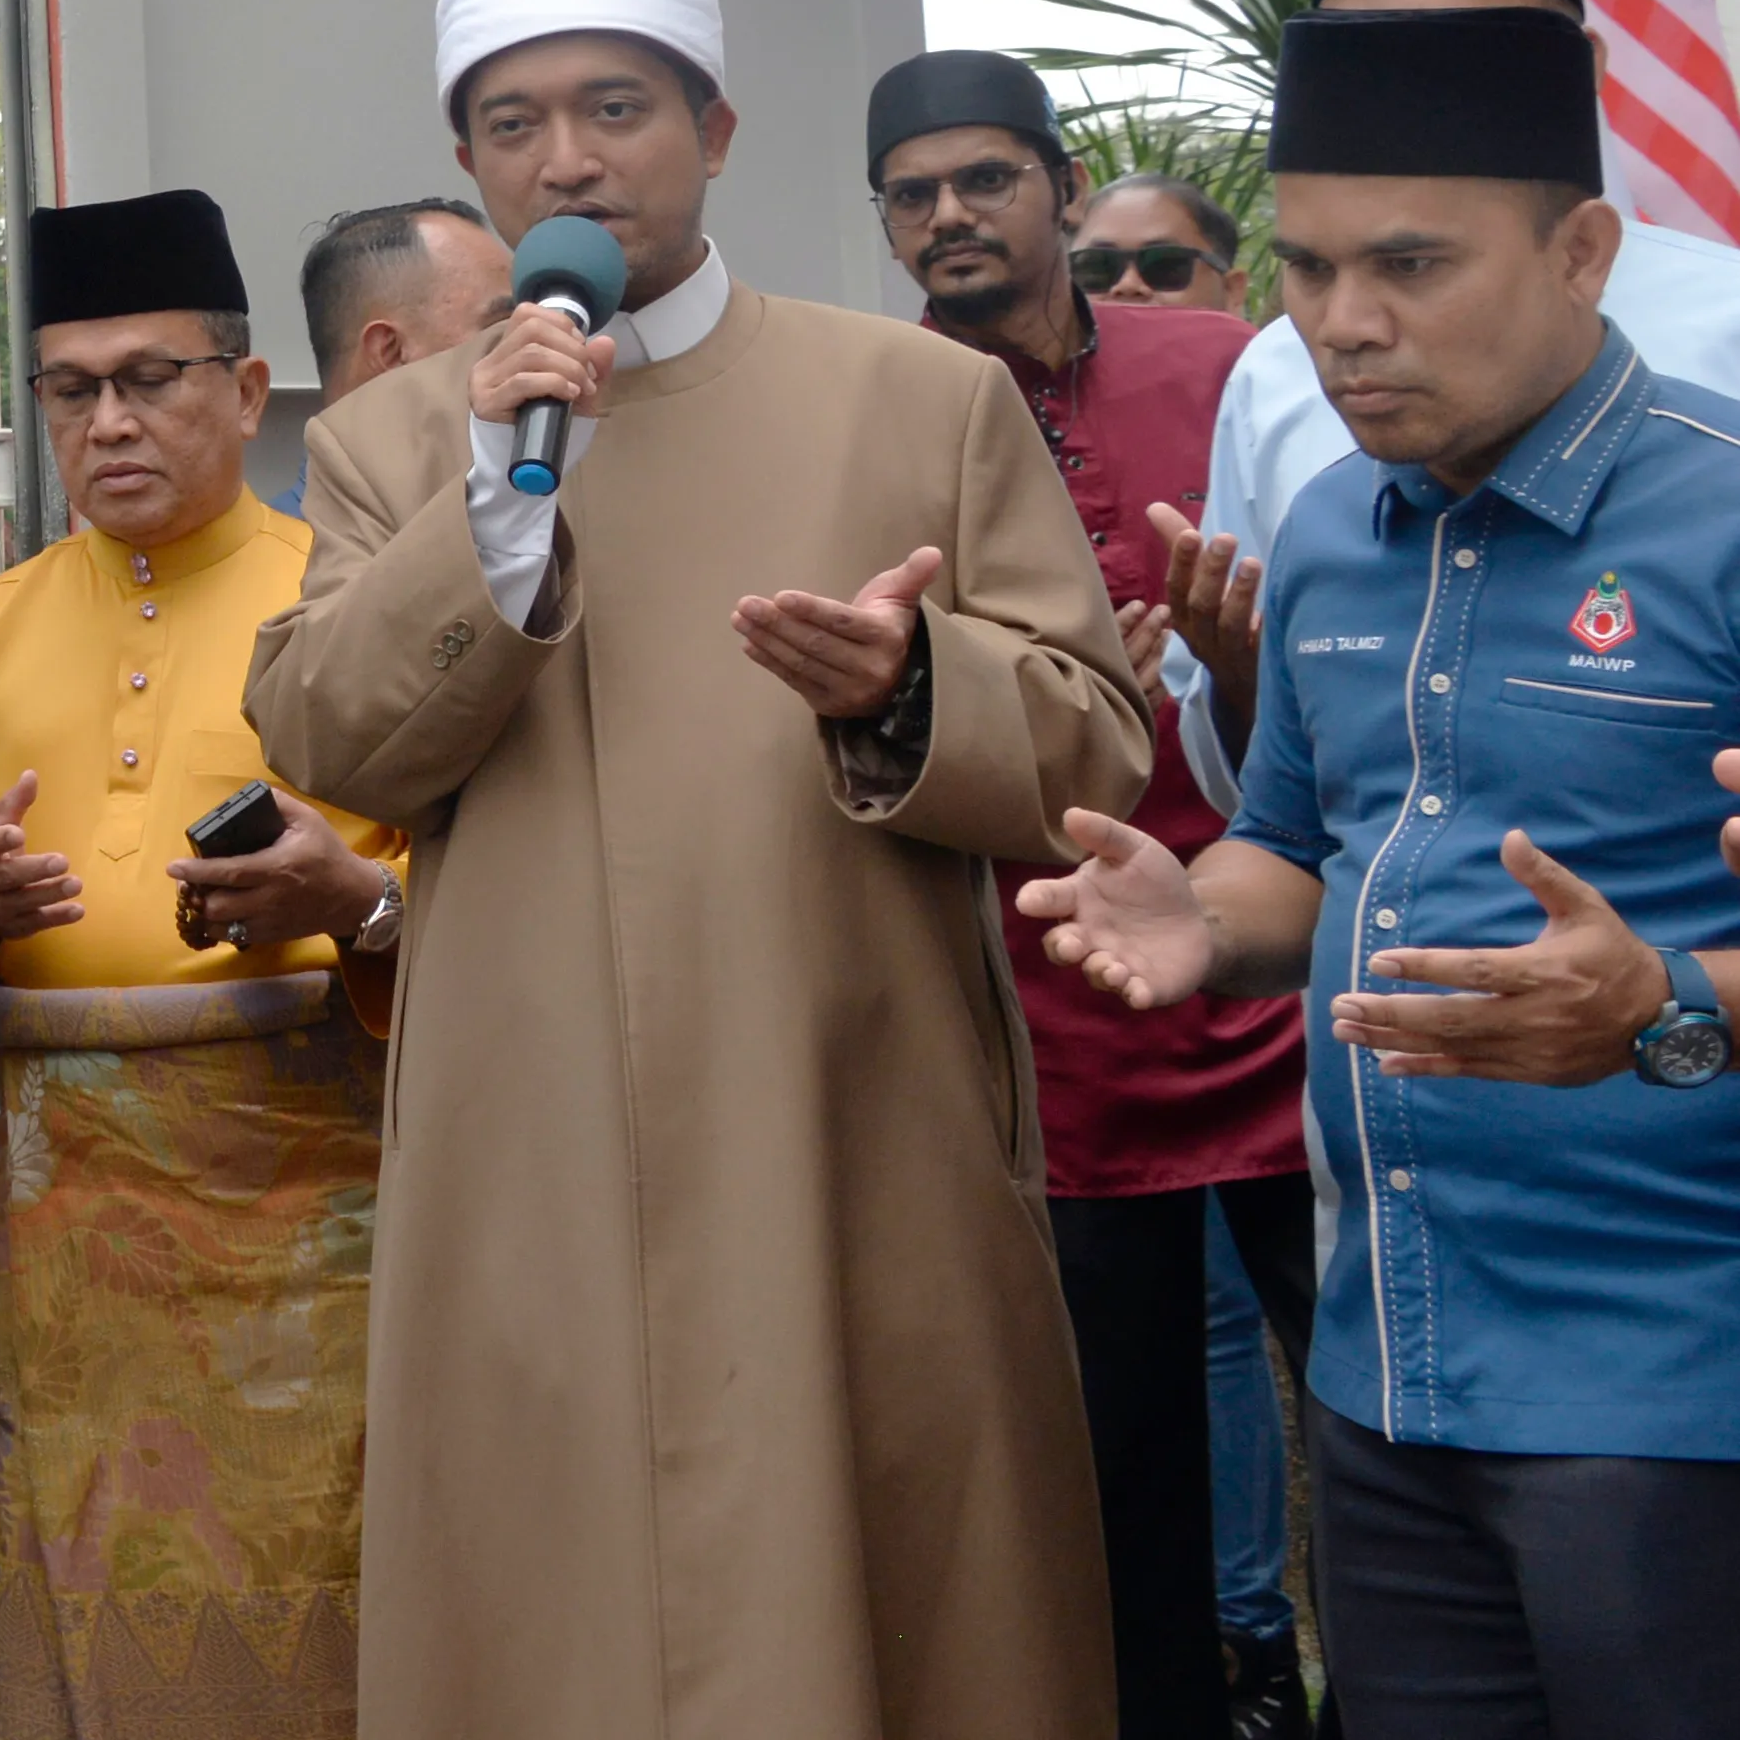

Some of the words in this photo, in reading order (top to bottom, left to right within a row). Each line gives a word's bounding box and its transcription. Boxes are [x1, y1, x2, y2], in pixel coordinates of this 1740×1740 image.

[1297, 639, 1333, 654] AHMAD
[1336, 636, 1385, 652] TALMIZI
[1569, 654, 1635, 672] MAIWP
